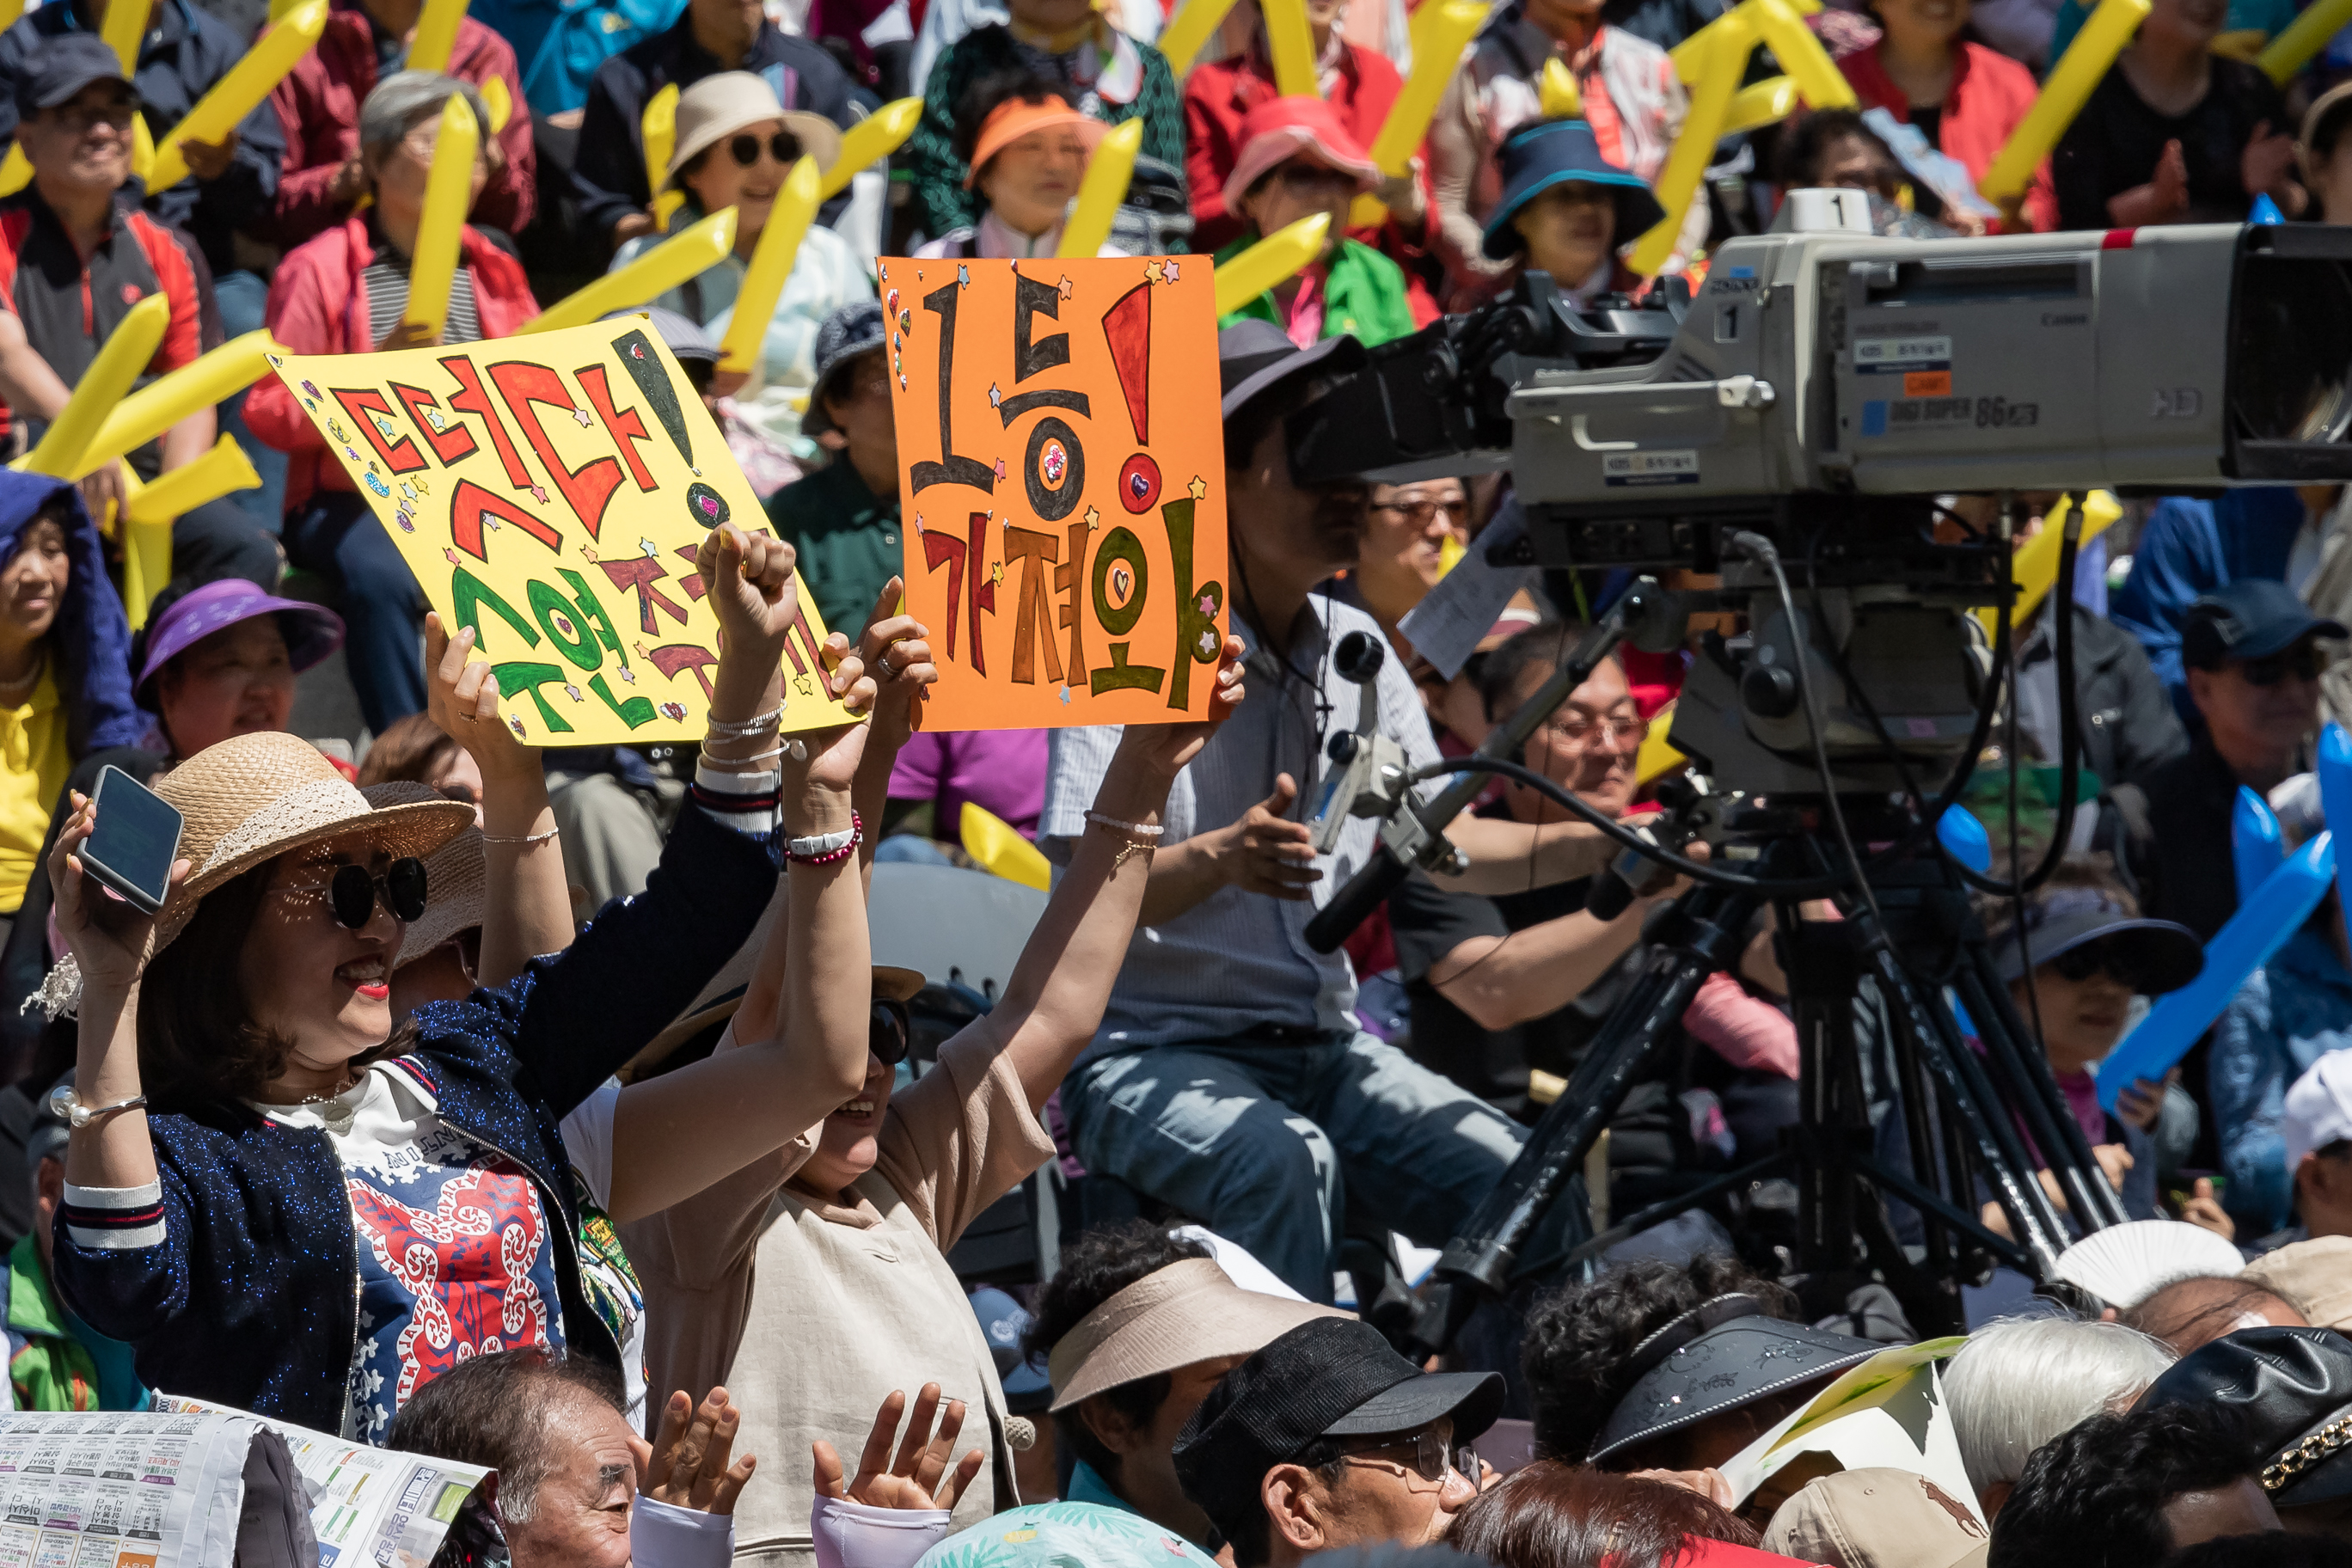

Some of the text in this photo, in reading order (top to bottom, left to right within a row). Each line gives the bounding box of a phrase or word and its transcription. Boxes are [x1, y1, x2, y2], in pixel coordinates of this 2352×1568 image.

[1830, 194, 1844, 227] 1
[1725, 306, 1737, 338] 1
[1975, 395, 2006, 429] 86
[922, 498, 1223, 711] 가져와
[9, 1504, 40, 1516] 미싱사
